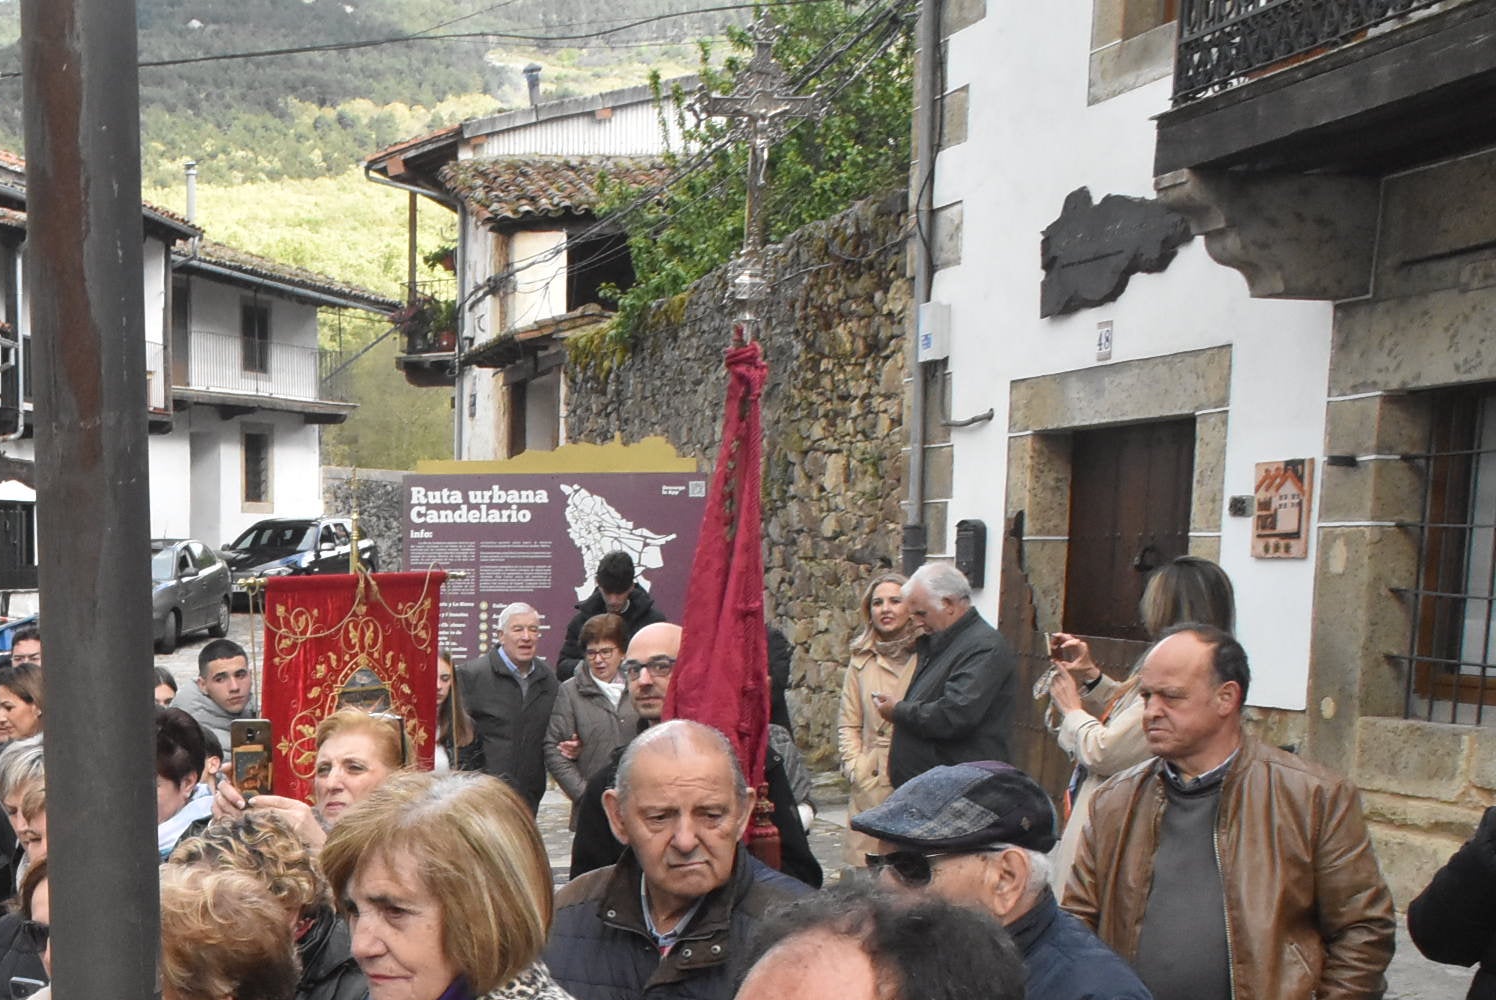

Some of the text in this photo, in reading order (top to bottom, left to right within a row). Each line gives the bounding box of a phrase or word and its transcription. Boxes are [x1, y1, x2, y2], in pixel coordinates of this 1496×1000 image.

[1097, 329, 1111, 351] 48
[410, 485, 549, 504] Ruta urbana
[410, 505, 532, 523] Candelario
